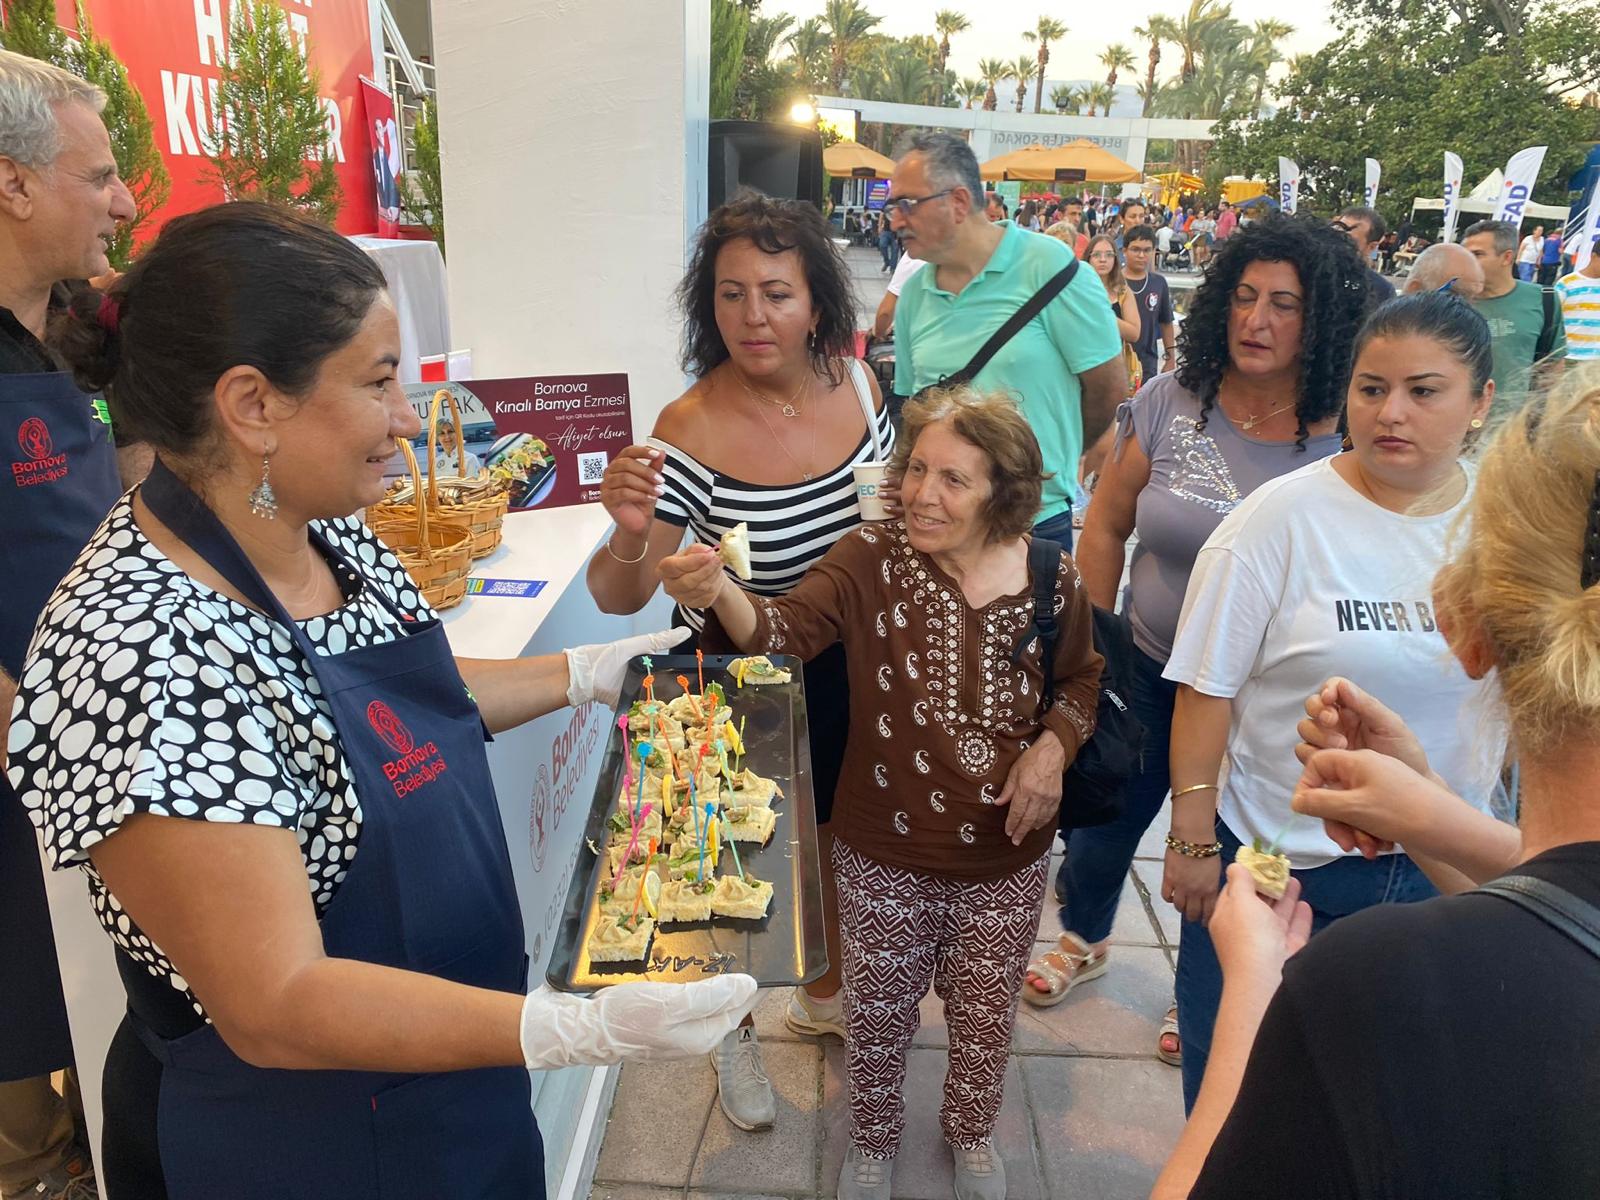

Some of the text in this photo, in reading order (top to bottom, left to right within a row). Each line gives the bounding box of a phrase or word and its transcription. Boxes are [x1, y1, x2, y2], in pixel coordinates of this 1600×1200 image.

[534, 382, 588, 395] Bornova
[495, 393, 626, 414] Kınalı Bamya Ezmesi
[546, 423, 627, 451] Afiyet olsun
[1335, 599, 1438, 633] NEVER B
[382, 742, 437, 781] Bornova
